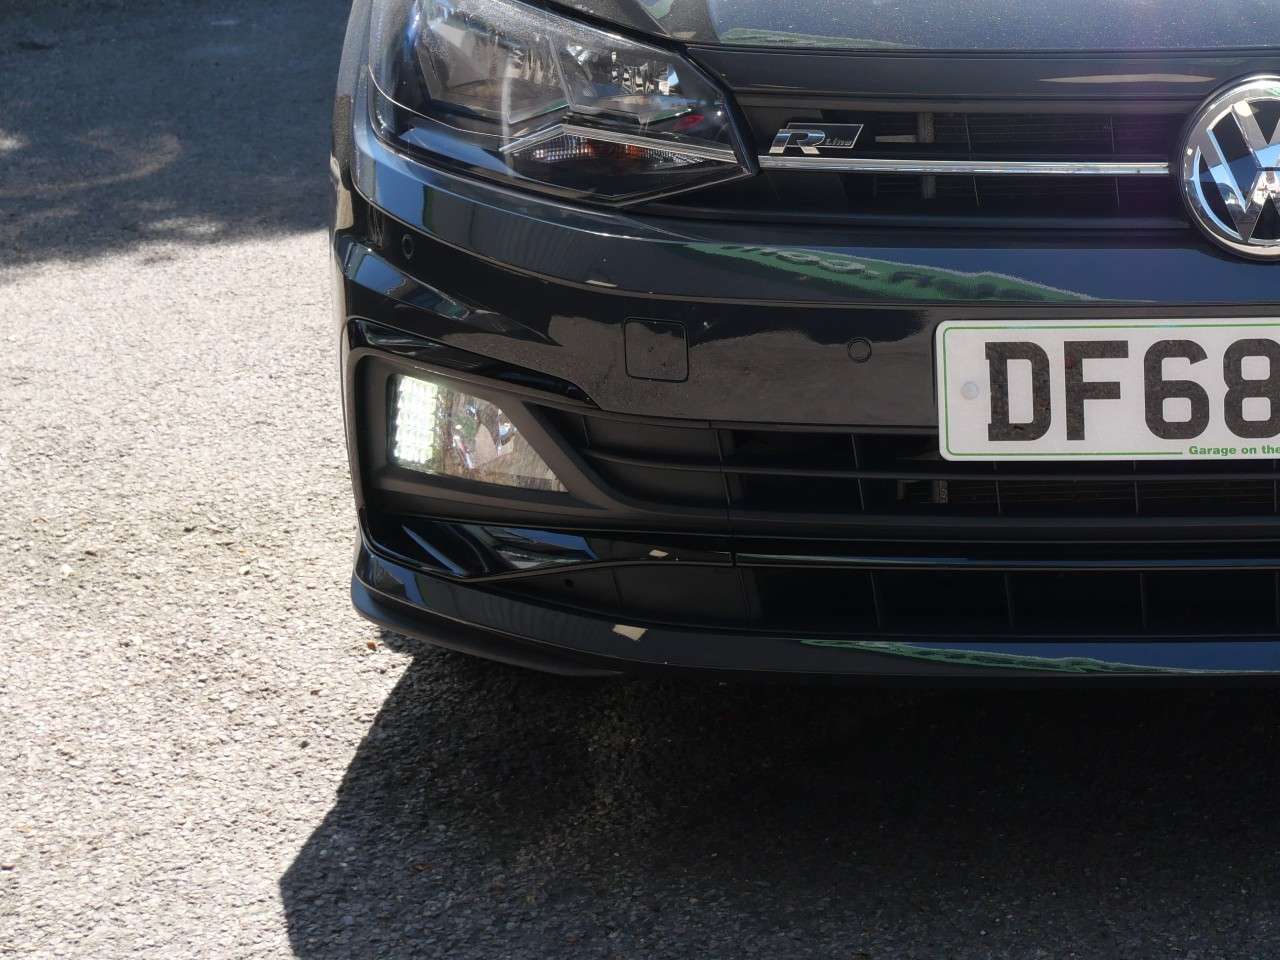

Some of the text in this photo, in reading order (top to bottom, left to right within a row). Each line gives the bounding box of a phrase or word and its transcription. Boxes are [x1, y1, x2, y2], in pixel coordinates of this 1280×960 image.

[769, 128, 826, 155] R
[1188, 445, 1237, 456] Garage
[1241, 446, 1257, 455] on
